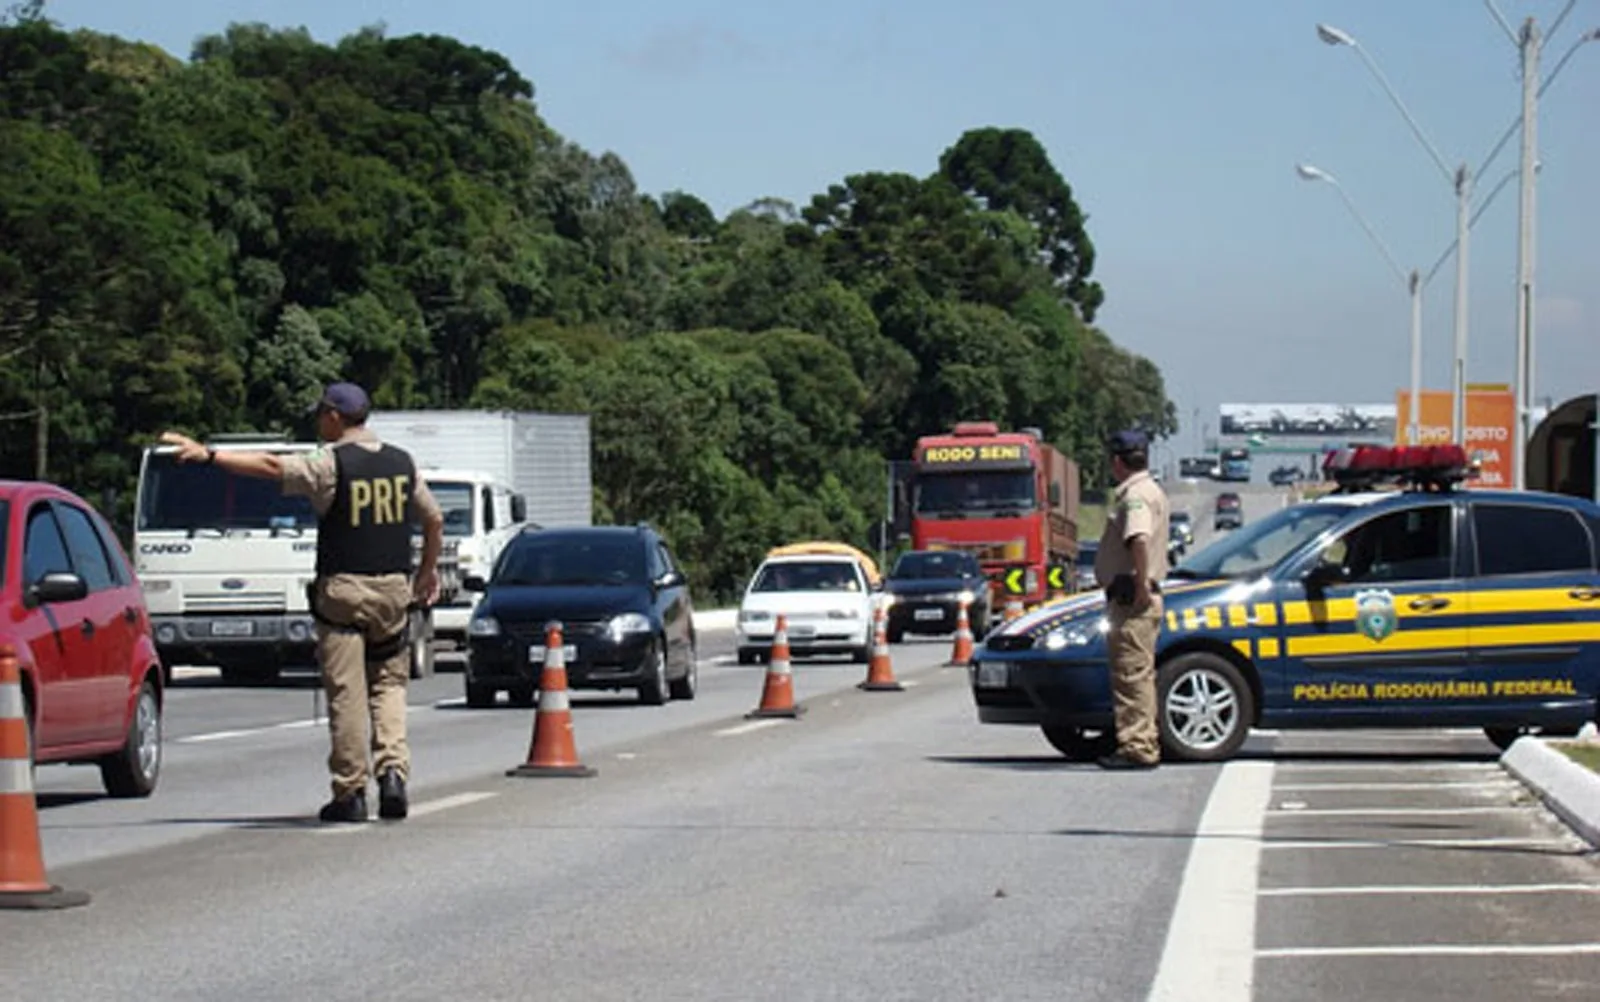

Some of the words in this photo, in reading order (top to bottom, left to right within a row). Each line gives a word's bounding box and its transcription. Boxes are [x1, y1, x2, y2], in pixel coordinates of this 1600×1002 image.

[1463, 427, 1508, 440] OSTO
[927, 447, 976, 463] RODO
[979, 446, 1020, 461] SENI
[350, 475, 409, 528] PRF
[140, 543, 193, 555] CARGO
[1293, 681, 1369, 700] POLÍCIA
[1373, 680, 1488, 699] RODOVIÁRIA
[1493, 679, 1577, 697] FEDERAL
